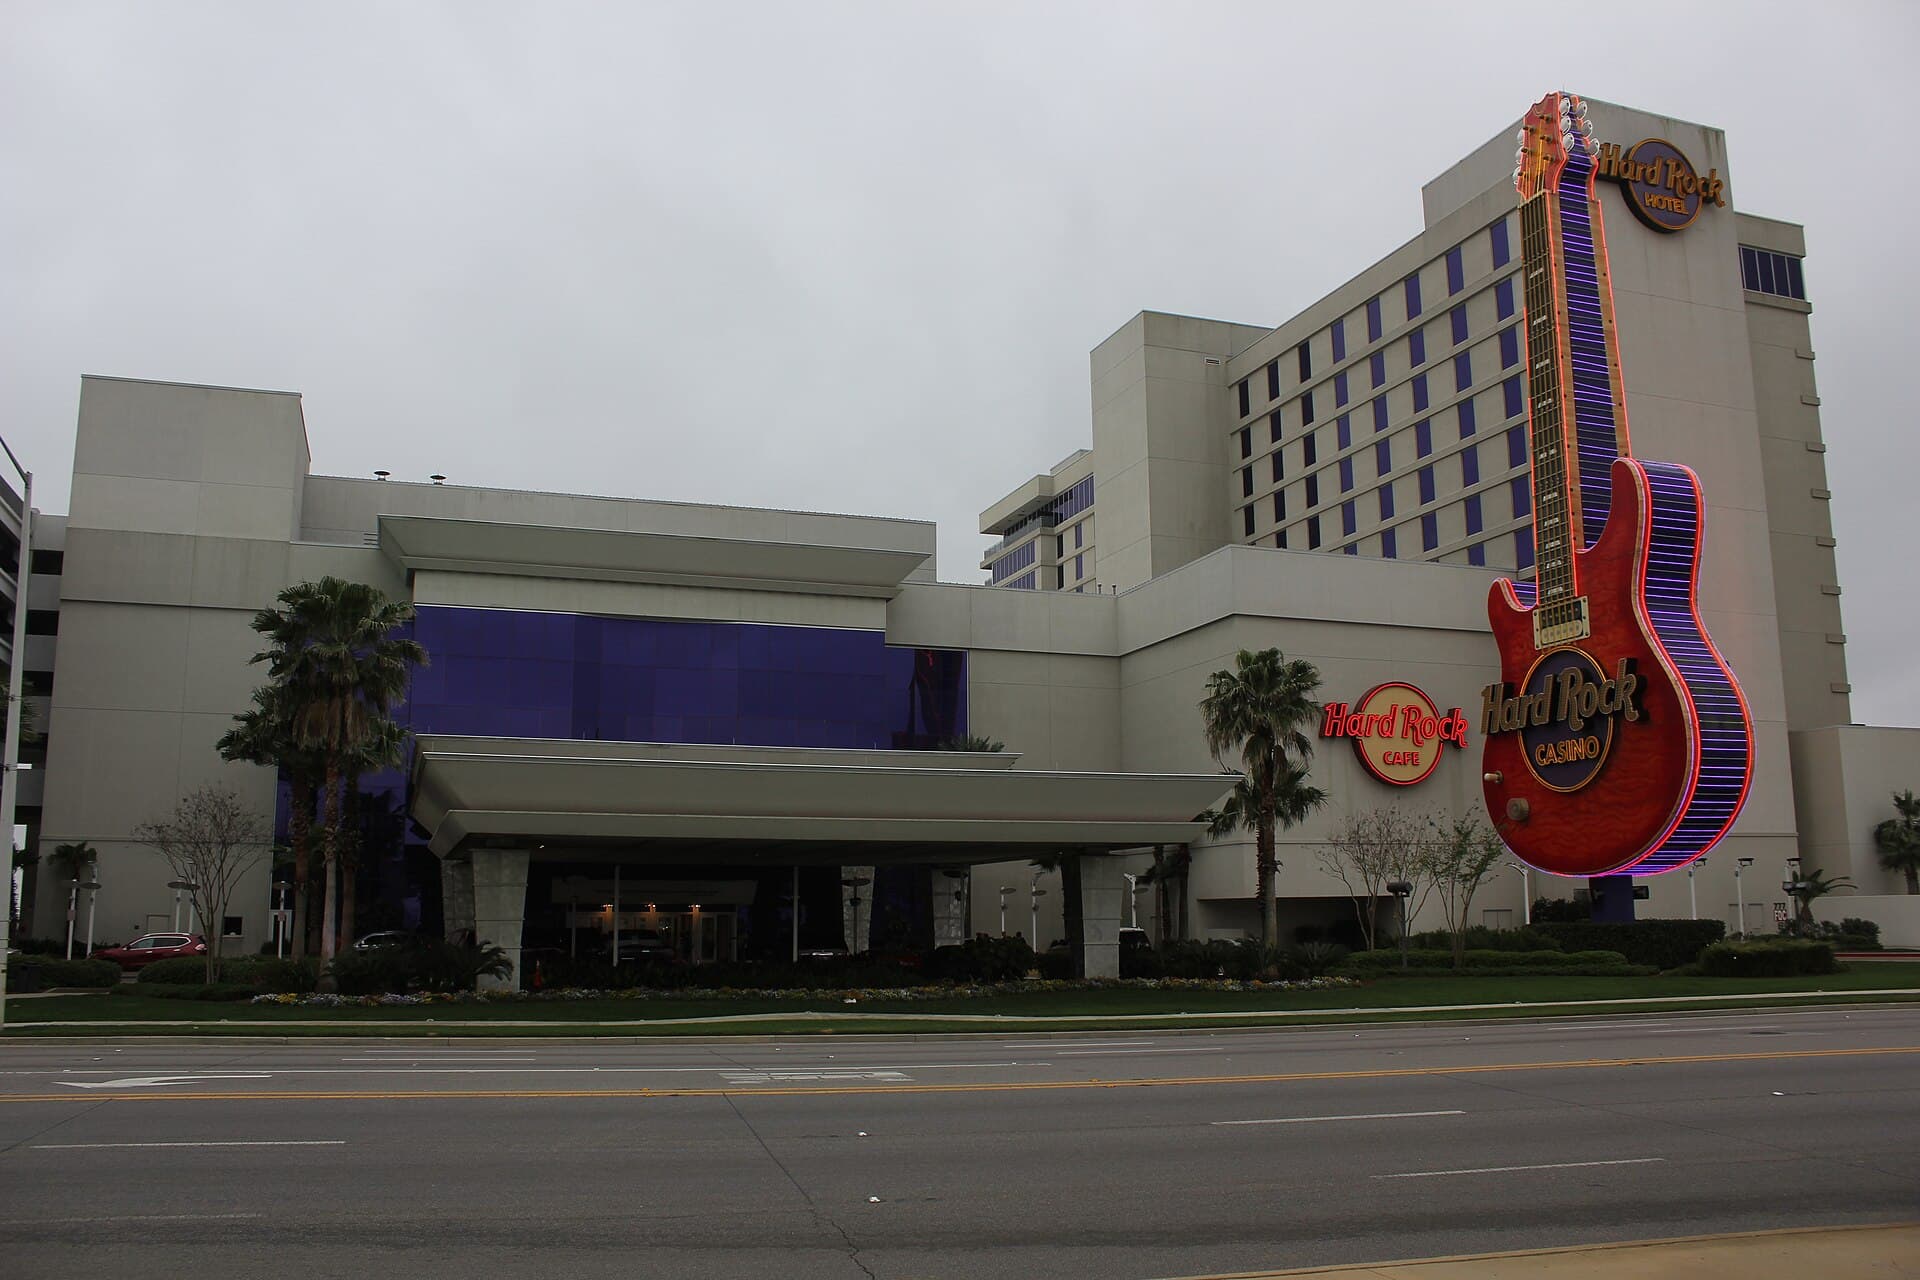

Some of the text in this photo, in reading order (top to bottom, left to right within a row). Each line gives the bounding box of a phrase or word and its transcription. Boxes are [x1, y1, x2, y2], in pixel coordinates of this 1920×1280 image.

[1599, 143, 1726, 208] Hard Rock
[1645, 192, 1688, 215] HOTEL
[1480, 657, 1640, 735] Hard Rock
[1324, 702, 1469, 749] Hard Rock
[1383, 751, 1421, 765] CAFE
[1535, 735, 1600, 767] CASINO
